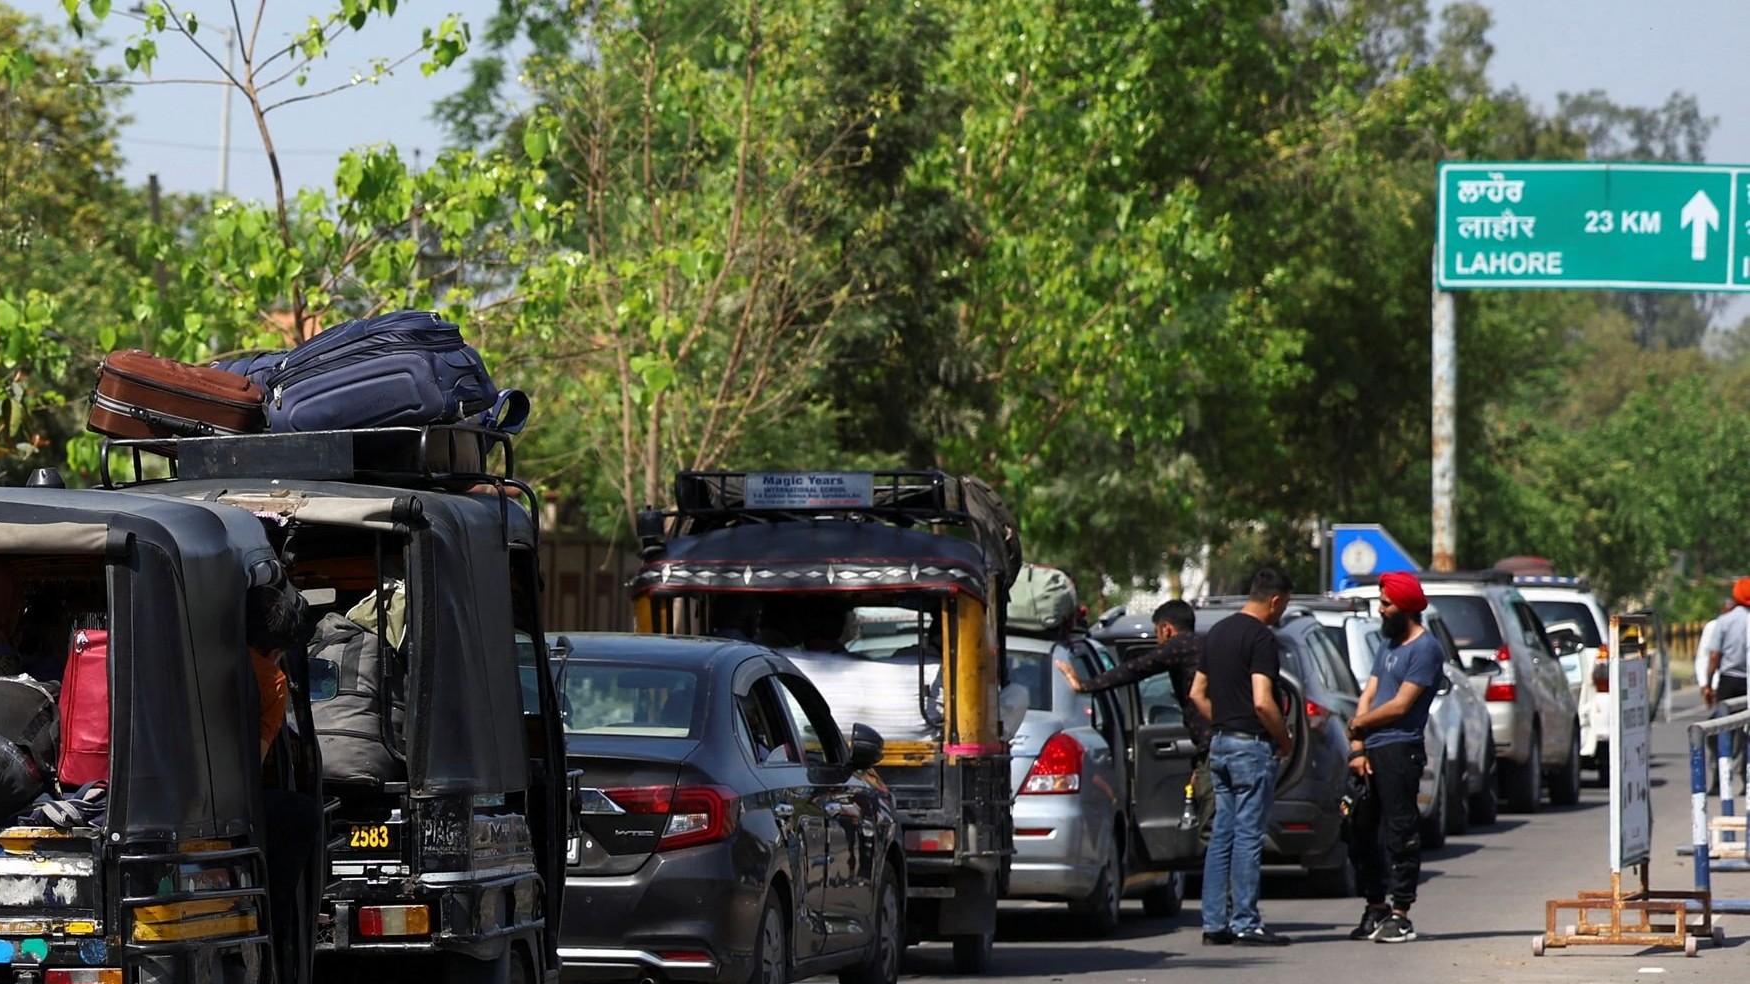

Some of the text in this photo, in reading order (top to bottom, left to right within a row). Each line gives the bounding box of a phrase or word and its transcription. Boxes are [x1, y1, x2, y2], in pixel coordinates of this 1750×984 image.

[1456, 208, 1536, 241] लाहौर
[1584, 210, 1661, 234] 23 KM
[1455, 252, 1563, 275] LAHORE
[763, 476, 844, 486] Magic Years
[350, 825, 389, 848] 2583
